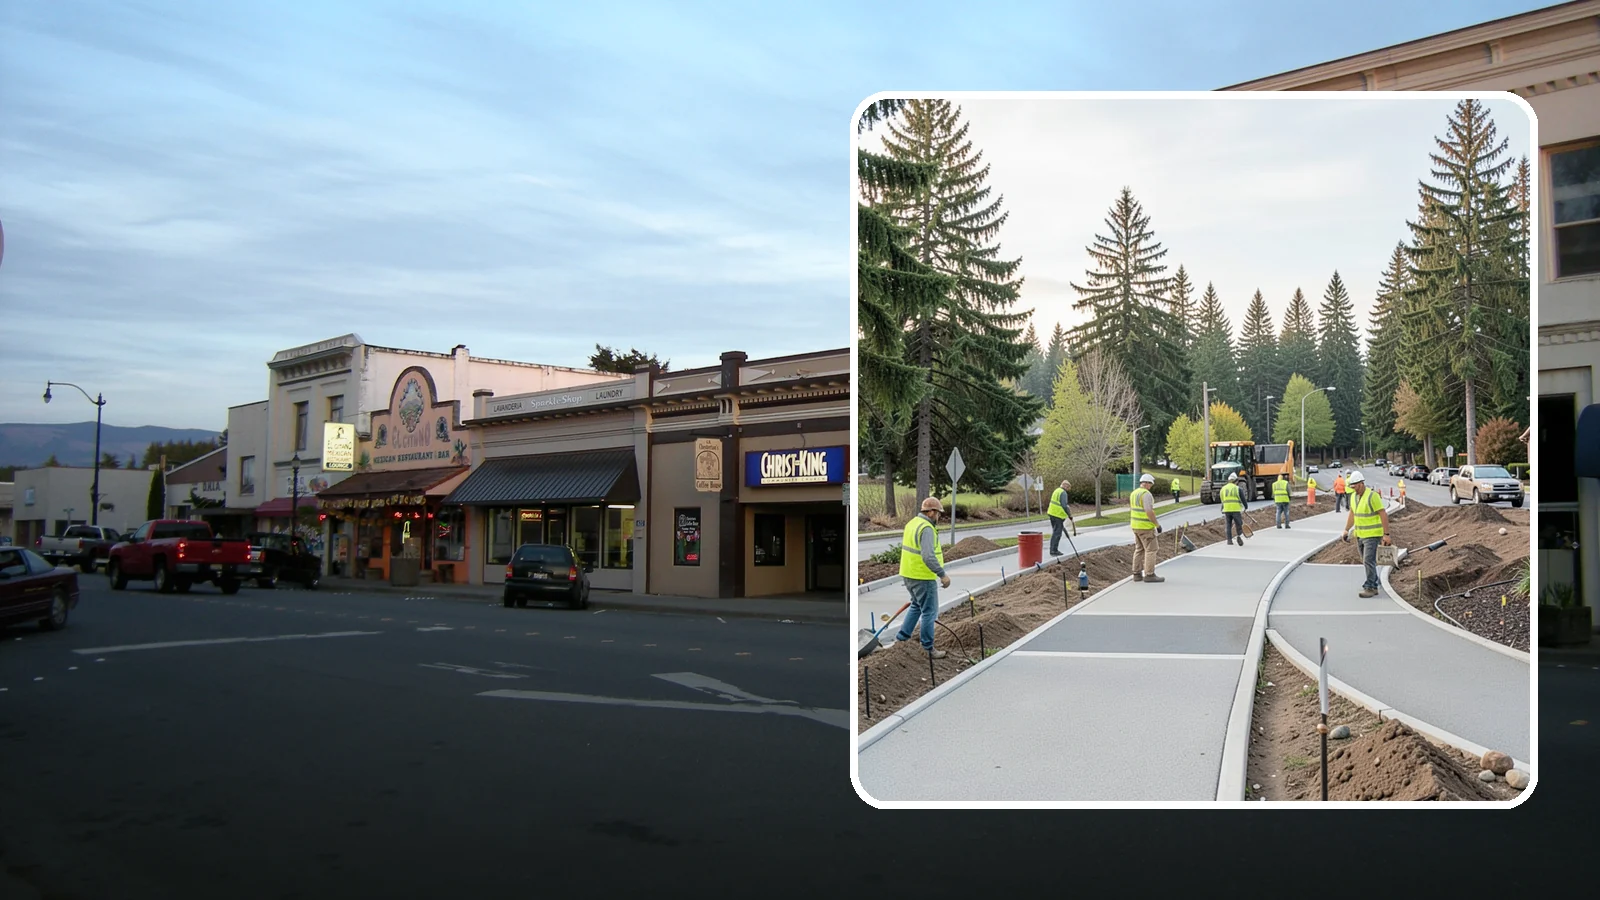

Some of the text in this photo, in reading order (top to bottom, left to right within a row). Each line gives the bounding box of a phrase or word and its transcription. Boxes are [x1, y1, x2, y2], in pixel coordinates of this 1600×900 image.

[531, 394, 582, 409] Sparkle Shop
[595, 389, 624, 400] LAUNDRY
[494, 402, 523, 413] LAVANDERIA
[374, 455, 396, 464] MEXICAN
[397, 451, 433, 463] RESTAURANT
[437, 450, 450, 459] BAR
[761, 450, 827, 478] CHRIST KING
